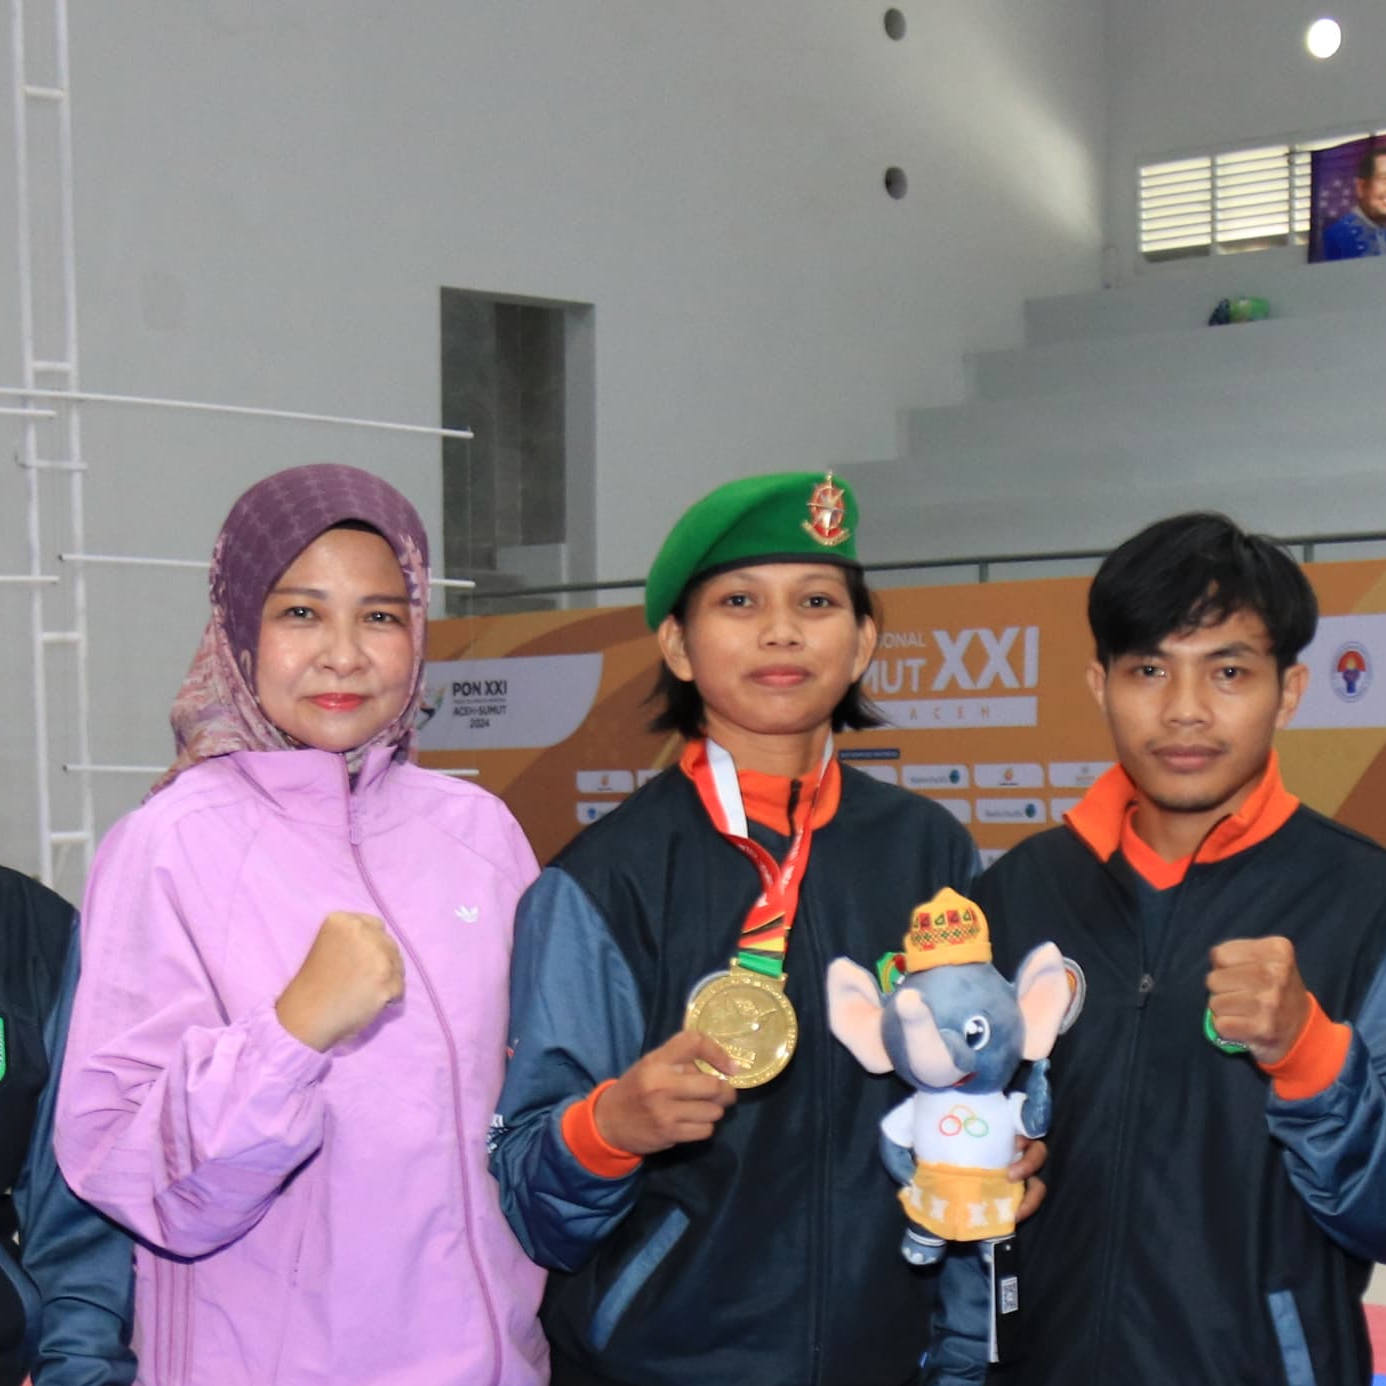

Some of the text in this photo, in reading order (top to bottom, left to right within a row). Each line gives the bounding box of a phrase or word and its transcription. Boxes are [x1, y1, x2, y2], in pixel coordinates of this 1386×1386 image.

[931, 626, 1040, 692] XXI
[863, 658, 928, 694] MUT
[452, 680, 508, 697] PON XXI
[453, 704, 507, 717] ACEH-SUMUT
[909, 705, 991, 721] ACEH
[469, 718, 490, 728] 2024
